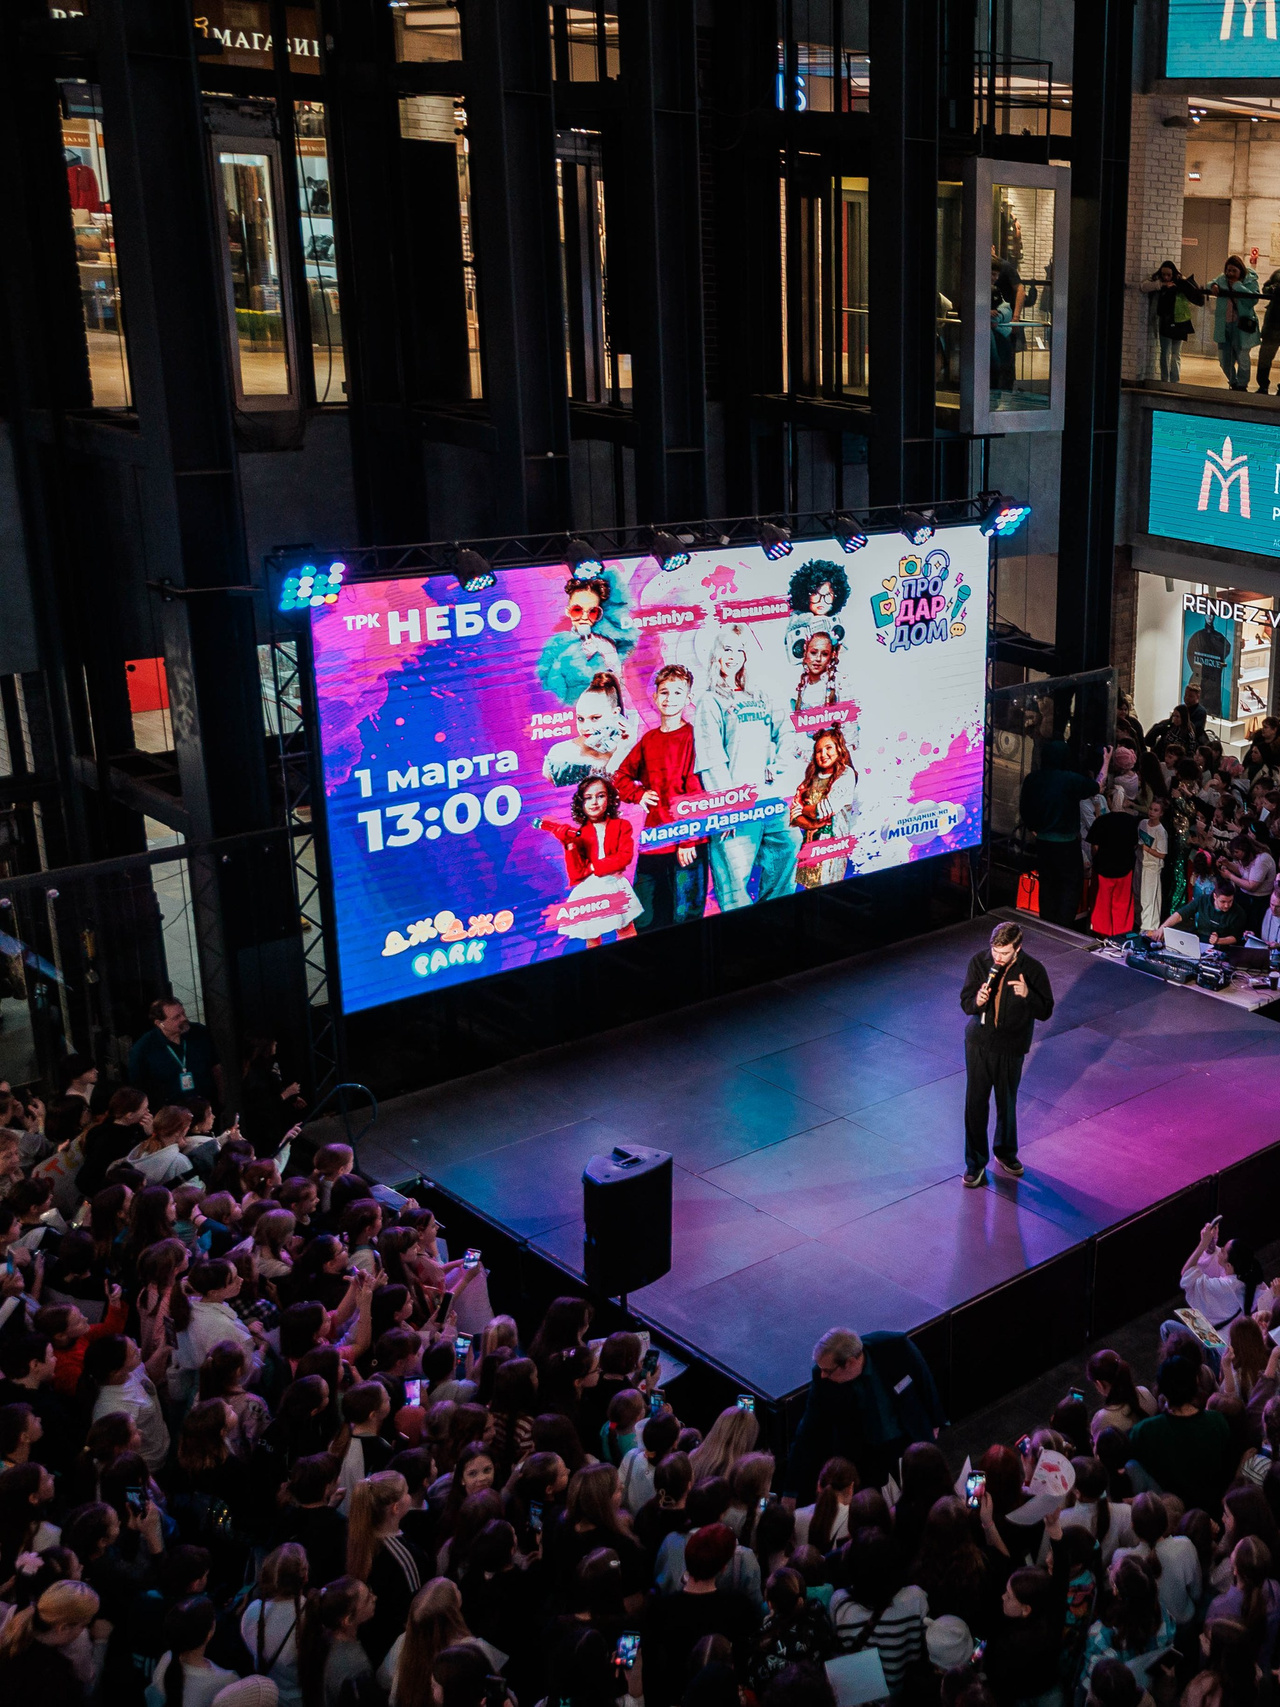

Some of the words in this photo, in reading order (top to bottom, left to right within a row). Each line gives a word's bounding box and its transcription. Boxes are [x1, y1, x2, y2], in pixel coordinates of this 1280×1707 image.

[901, 575, 944, 600] ПРО
[343, 613, 382, 632] ТРК
[387, 599, 522, 645] НЕБО
[620, 608, 695, 630] Darsiniya
[722, 600, 789, 620] Равшана
[895, 595, 946, 626] ДАР
[890, 618, 948, 653] ДОМ
[530, 710, 575, 728] Леди
[797, 708, 850, 728] Naniray
[530, 725, 572, 742] Леся
[354, 768, 372, 797] 1
[387, 750, 519, 791] марта
[676, 788, 752, 816] СтешОК
[358, 784, 522, 853] 13:00
[640, 821, 701, 845] Макар
[705, 801, 786, 832] Давыдов
[556, 899, 610, 922] Арика
[412, 939, 488, 978] PARK
